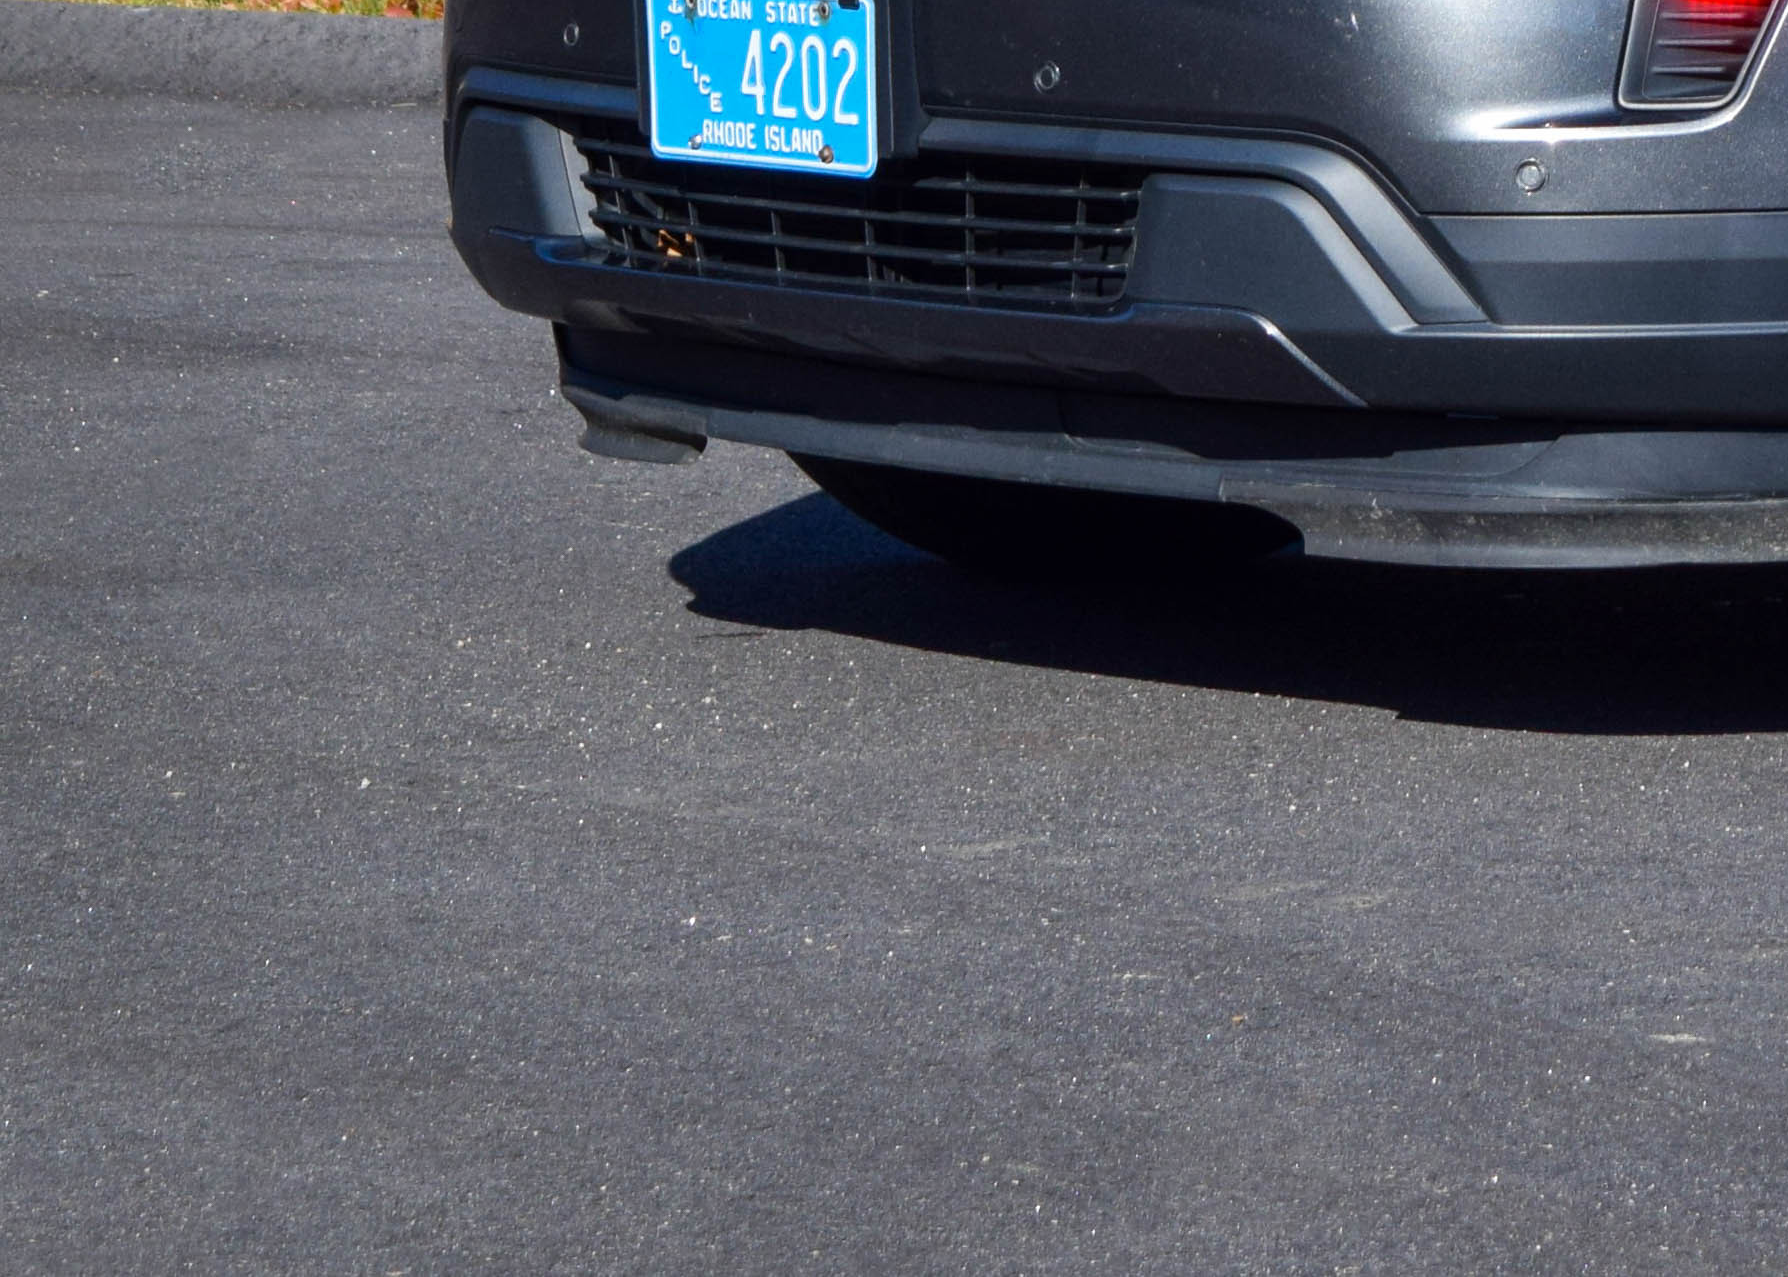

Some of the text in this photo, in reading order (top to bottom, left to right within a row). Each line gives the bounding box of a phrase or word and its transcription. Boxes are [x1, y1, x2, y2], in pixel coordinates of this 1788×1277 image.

[765, 1, 820, 26] STATE
[660, 20, 723, 113] POLICE
[740, 28, 860, 126] 4202
[701, 119, 825, 154] RHODE ISLAND
